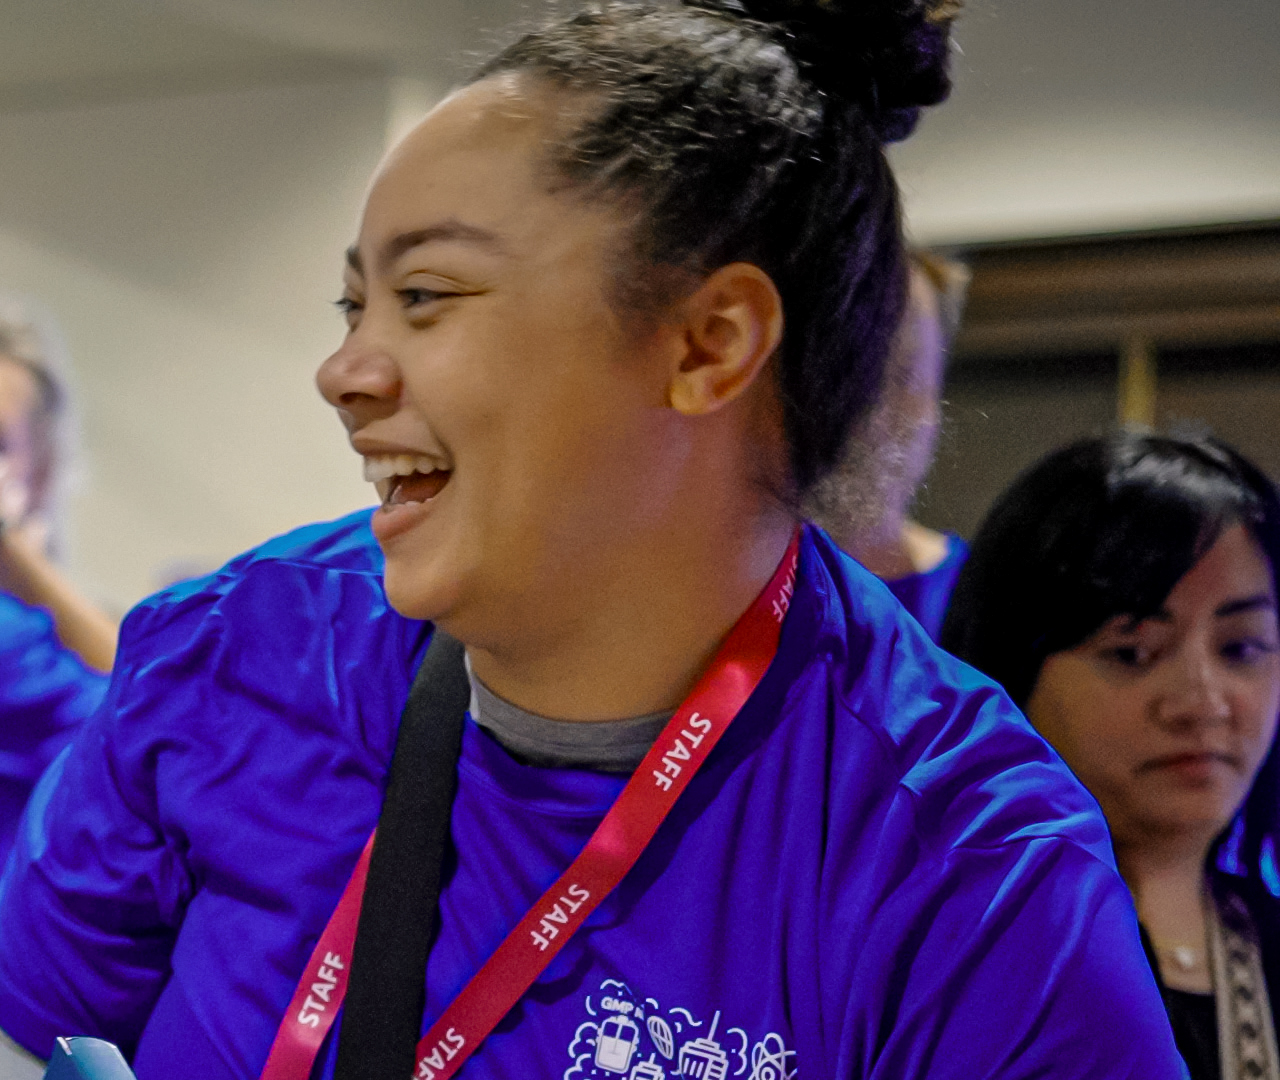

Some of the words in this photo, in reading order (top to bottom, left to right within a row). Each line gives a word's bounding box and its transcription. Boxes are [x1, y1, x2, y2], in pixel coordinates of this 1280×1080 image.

[653, 712, 711, 791] STAFF
[531, 884, 589, 951] STAFF
[298, 952, 344, 1028] STAFF
